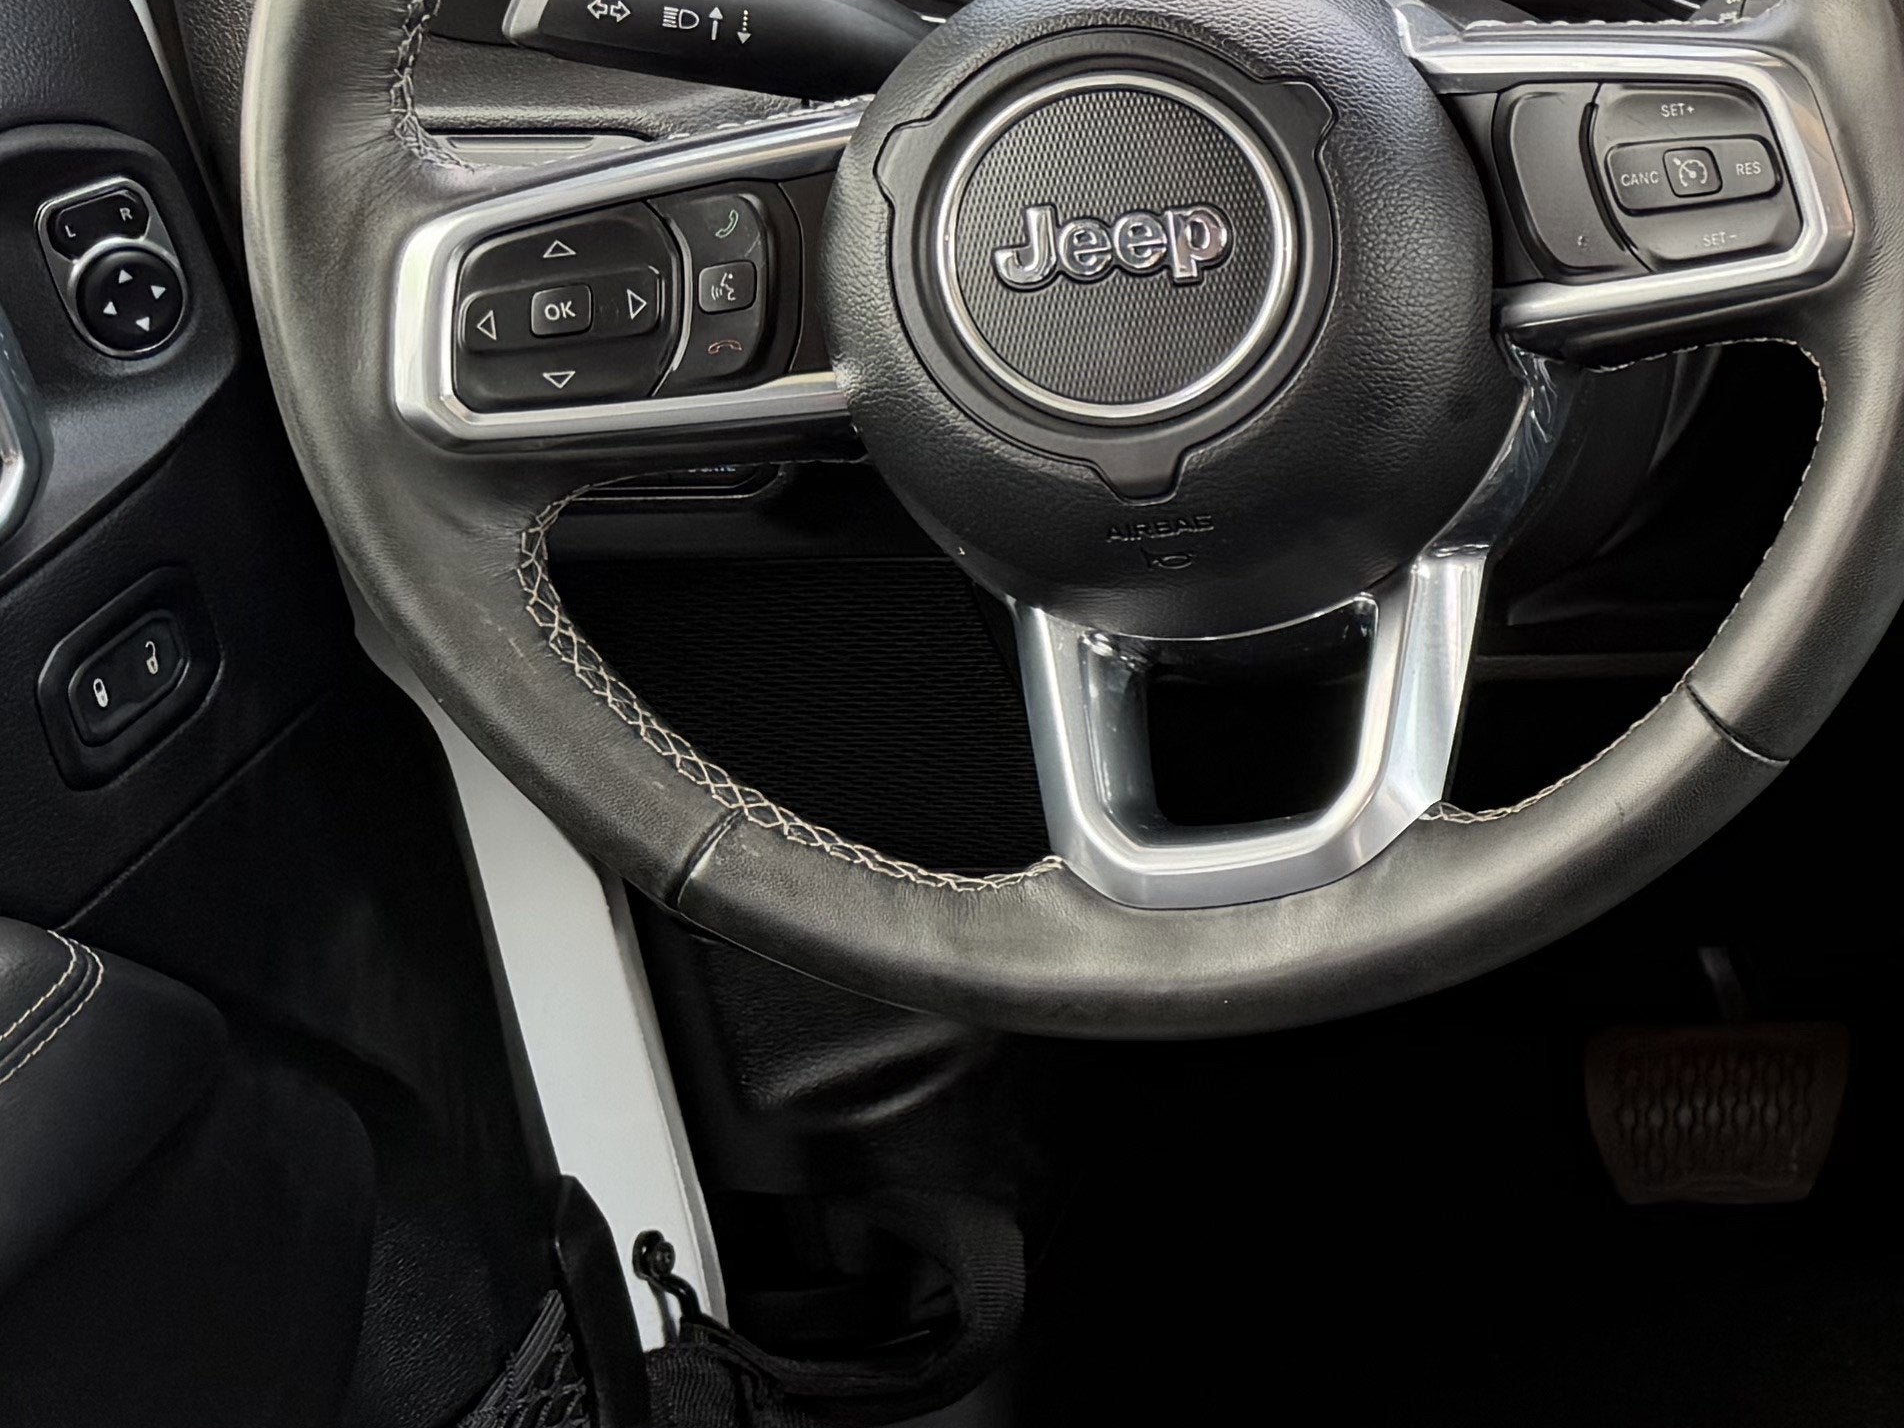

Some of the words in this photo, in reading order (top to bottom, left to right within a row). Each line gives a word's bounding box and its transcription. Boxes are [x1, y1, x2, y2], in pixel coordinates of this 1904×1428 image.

[1736, 162, 1761, 176] RES
[1621, 171, 1660, 187] CANC
[119, 207, 132, 221] R
[63, 224, 77, 239] L
[995, 205, 1232, 292] Jeep
[544, 299, 576, 323] OK
